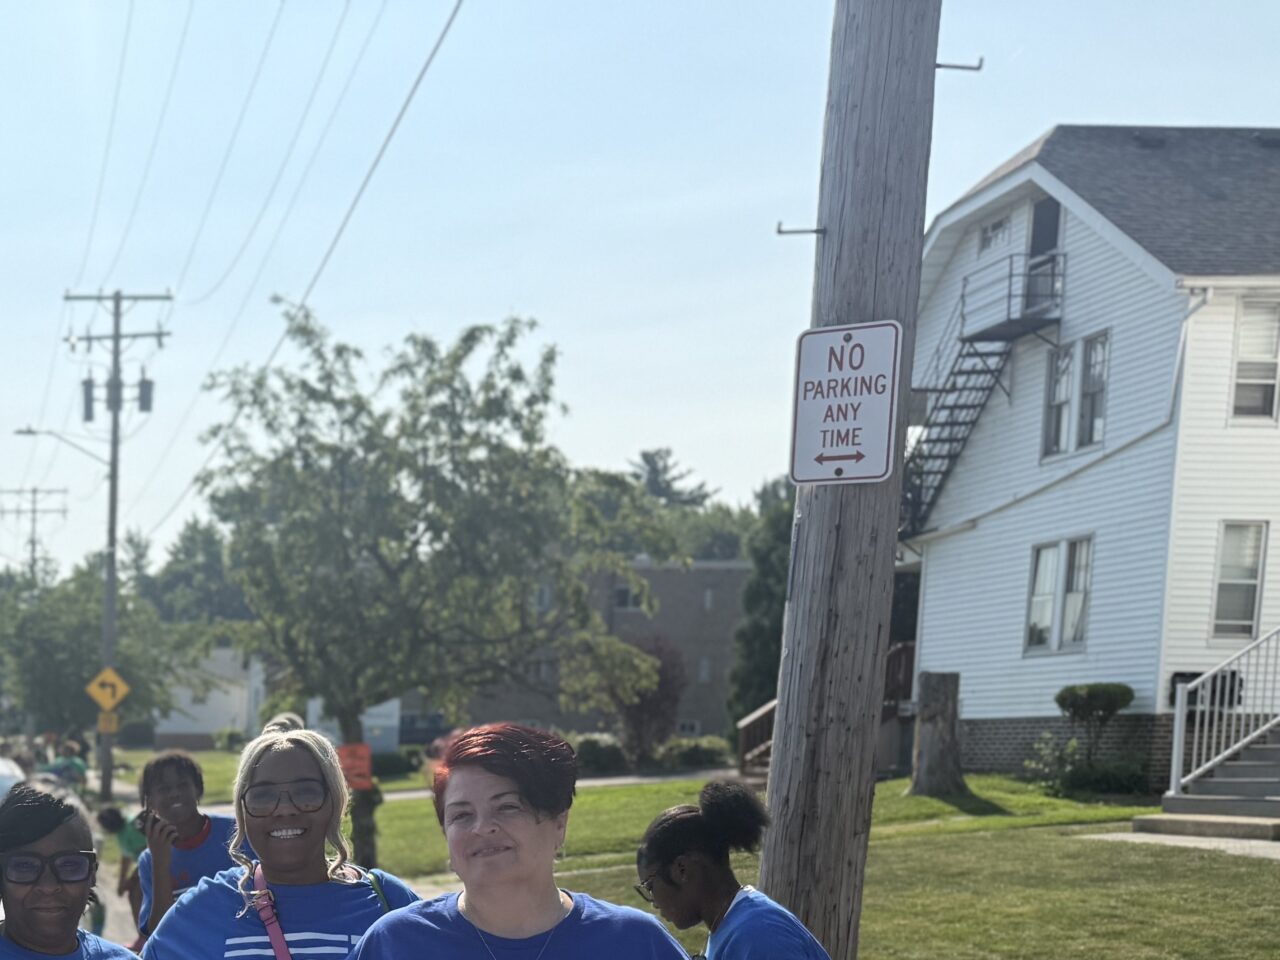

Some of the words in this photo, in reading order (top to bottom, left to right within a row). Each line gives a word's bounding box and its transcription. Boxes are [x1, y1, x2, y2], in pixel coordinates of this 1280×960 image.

[827, 343, 865, 373] NO
[803, 374, 887, 400] PARKING
[823, 402, 862, 423] ANY
[820, 427, 863, 448] TIME
